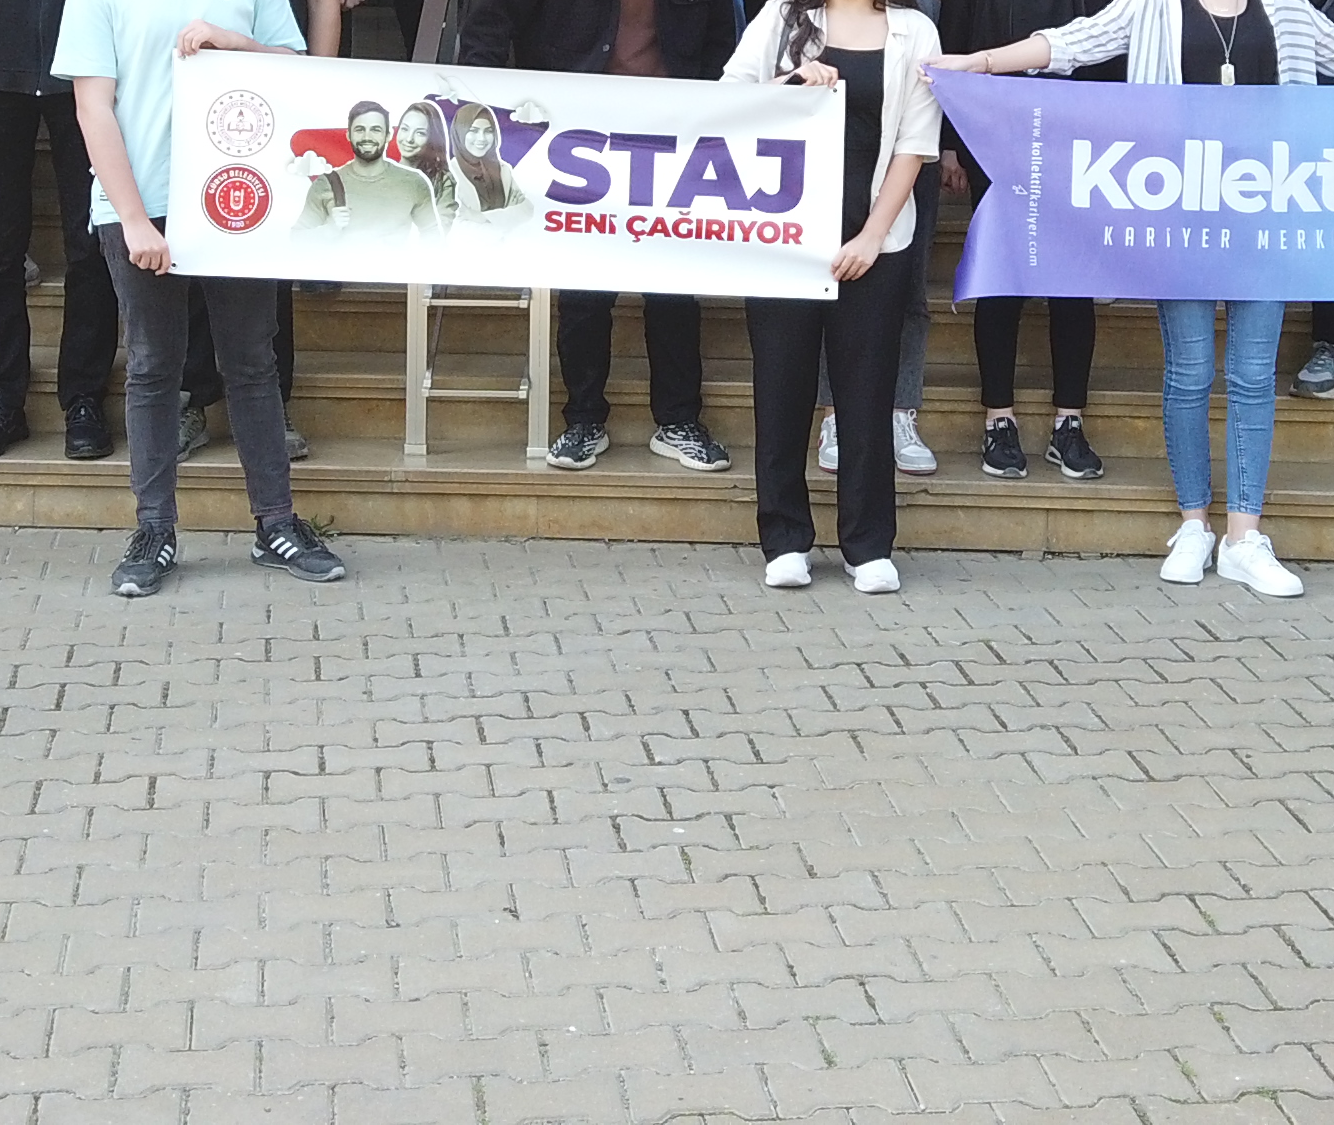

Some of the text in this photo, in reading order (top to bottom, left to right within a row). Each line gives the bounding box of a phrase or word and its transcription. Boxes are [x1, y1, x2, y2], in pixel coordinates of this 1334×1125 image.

[544, 128, 807, 214] STAJ
[1026, 107, 1044, 266] www.kollektifkariyer.com
[544, 210, 804, 245] SENİ ÇAĞIRIYOR
[1103, 225, 1231, 249] KARİYER
